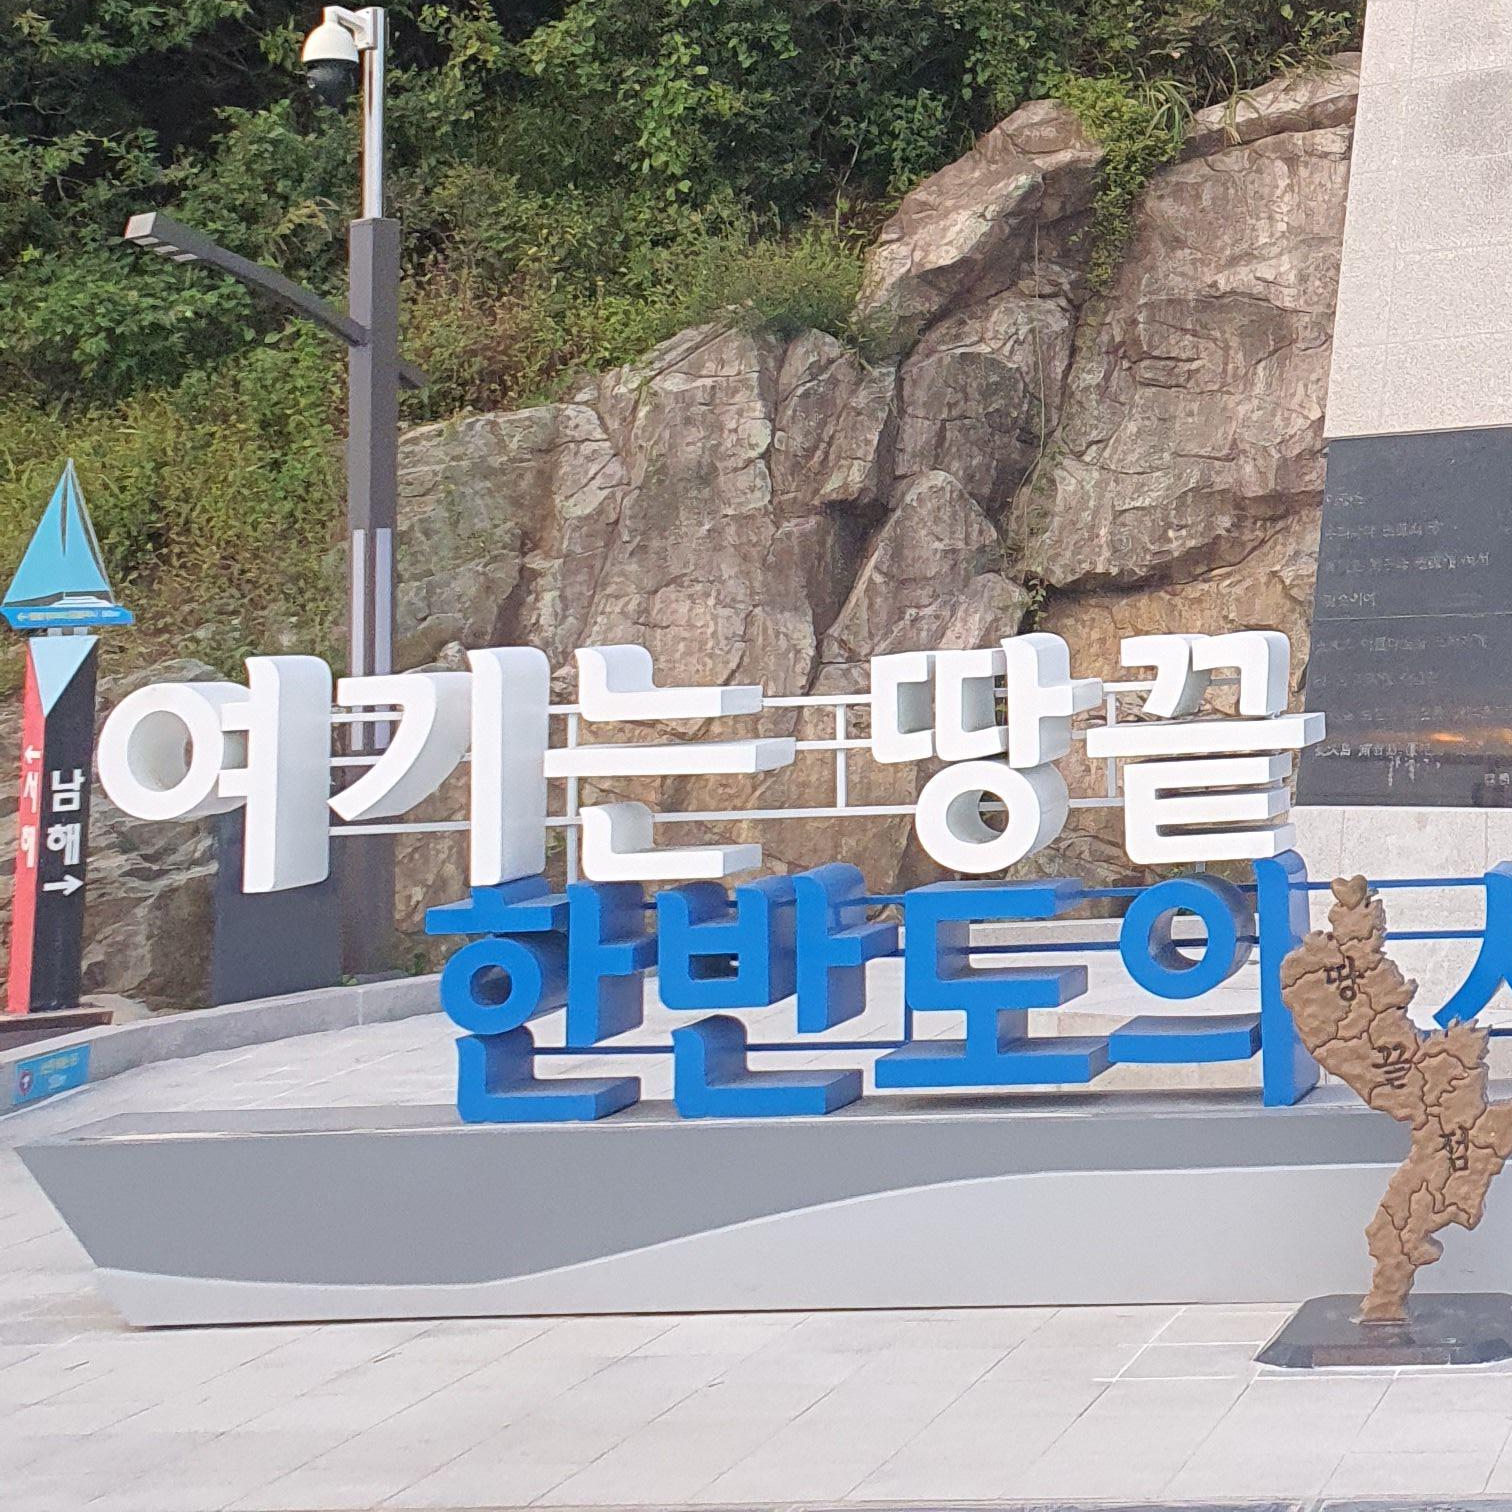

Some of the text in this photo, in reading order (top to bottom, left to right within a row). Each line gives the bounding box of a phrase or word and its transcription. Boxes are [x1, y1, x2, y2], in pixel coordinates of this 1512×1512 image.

[46, 768, 86, 866] 남해
[97, 630, 1325, 894] 여기는 땅끝
[425, 852, 1318, 1123] 한반도의
